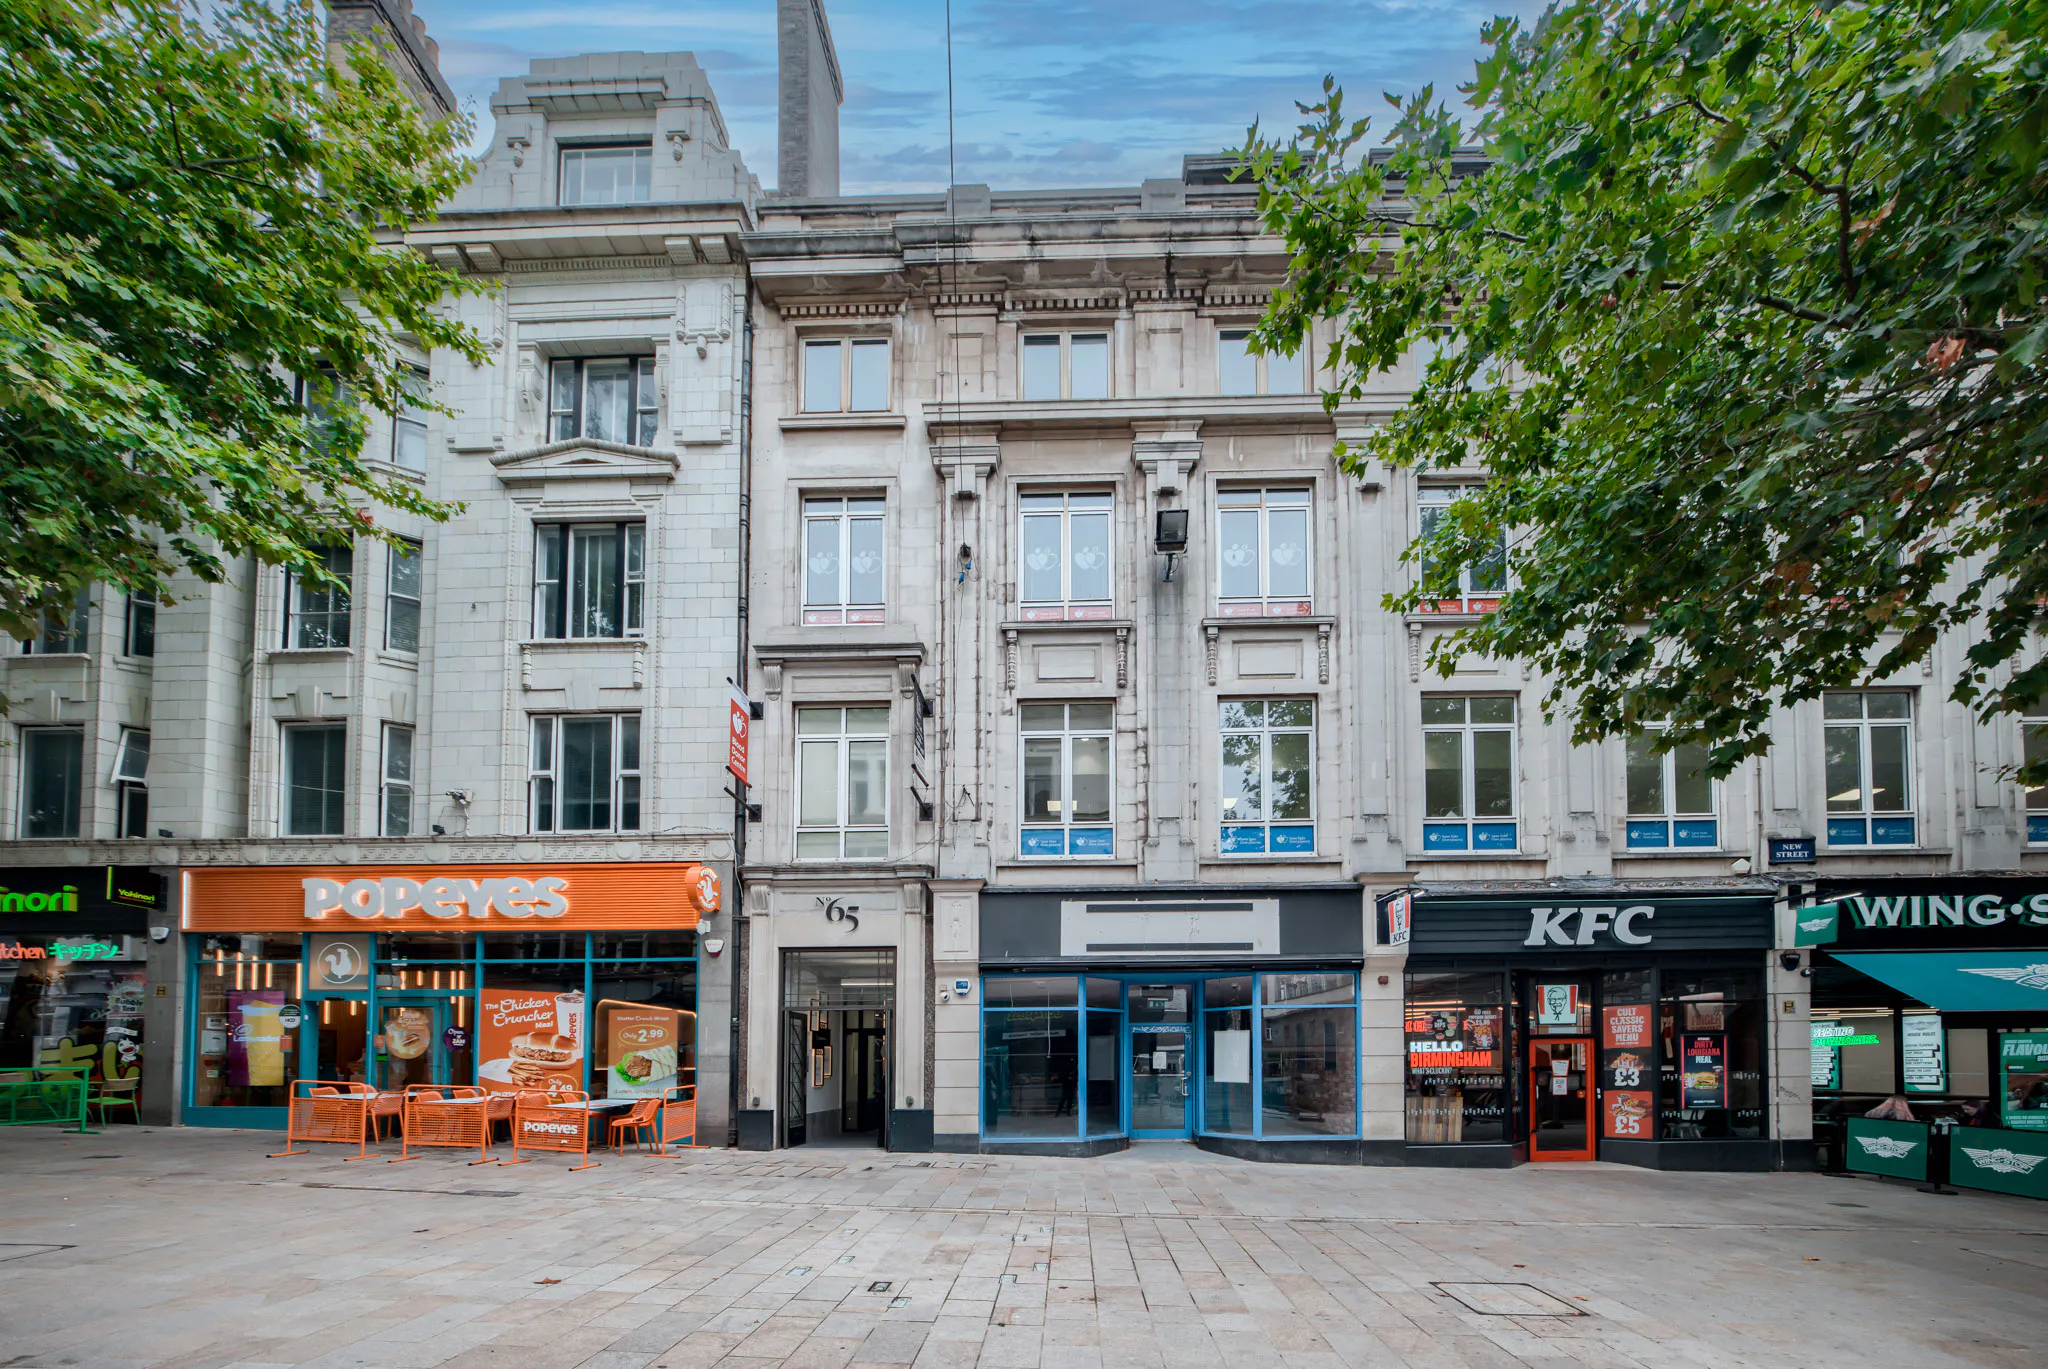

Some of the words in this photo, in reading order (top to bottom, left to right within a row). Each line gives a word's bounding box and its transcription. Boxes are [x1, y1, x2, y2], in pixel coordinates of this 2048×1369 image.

[731, 736, 745, 753] Blood
[731, 746, 746, 763] Donor
[731, 756, 746, 773] Centre
[1782, 843, 1803, 851] NEW
[825, 896, 860, 934] 65
[1523, 905, 1656, 946] KFC
[1392, 930, 1407, 944] KFC
[48, 942, 119, 960] キッチン
[484, 1002, 499, 1010] The
[500, 997, 551, 1013] Chicken
[1616, 1007, 1637, 1017] CULT
[493, 1010, 554, 1027] Cruncher
[535, 1021, 554, 1029] Meal
[1609, 1015, 1645, 1026] CLASSIC
[623, 1031, 637, 1040] Only
[638, 1028, 664, 1043] 2.99
[1611, 1024, 1643, 1034] SAVERS
[1813, 1026, 1855, 1038] SEATING
[1615, 1033, 1639, 1042] MENU
[1693, 1040, 1714, 1049] DIRTY
[1409, 1040, 1463, 1053] HELLO
[1687, 1047, 1721, 1056] LOUISIANA
[1410, 1051, 1492, 1068] BIRMINGHAM
[1695, 1055, 1713, 1064] MEAL
[1411, 1067, 1430, 1075] WHAT'S
[1614, 1068, 1640, 1087] £3
[548, 1078, 563, 1086] Only
[546, 1084, 573, 1098] 449
[1614, 1115, 1640, 1134] £5
